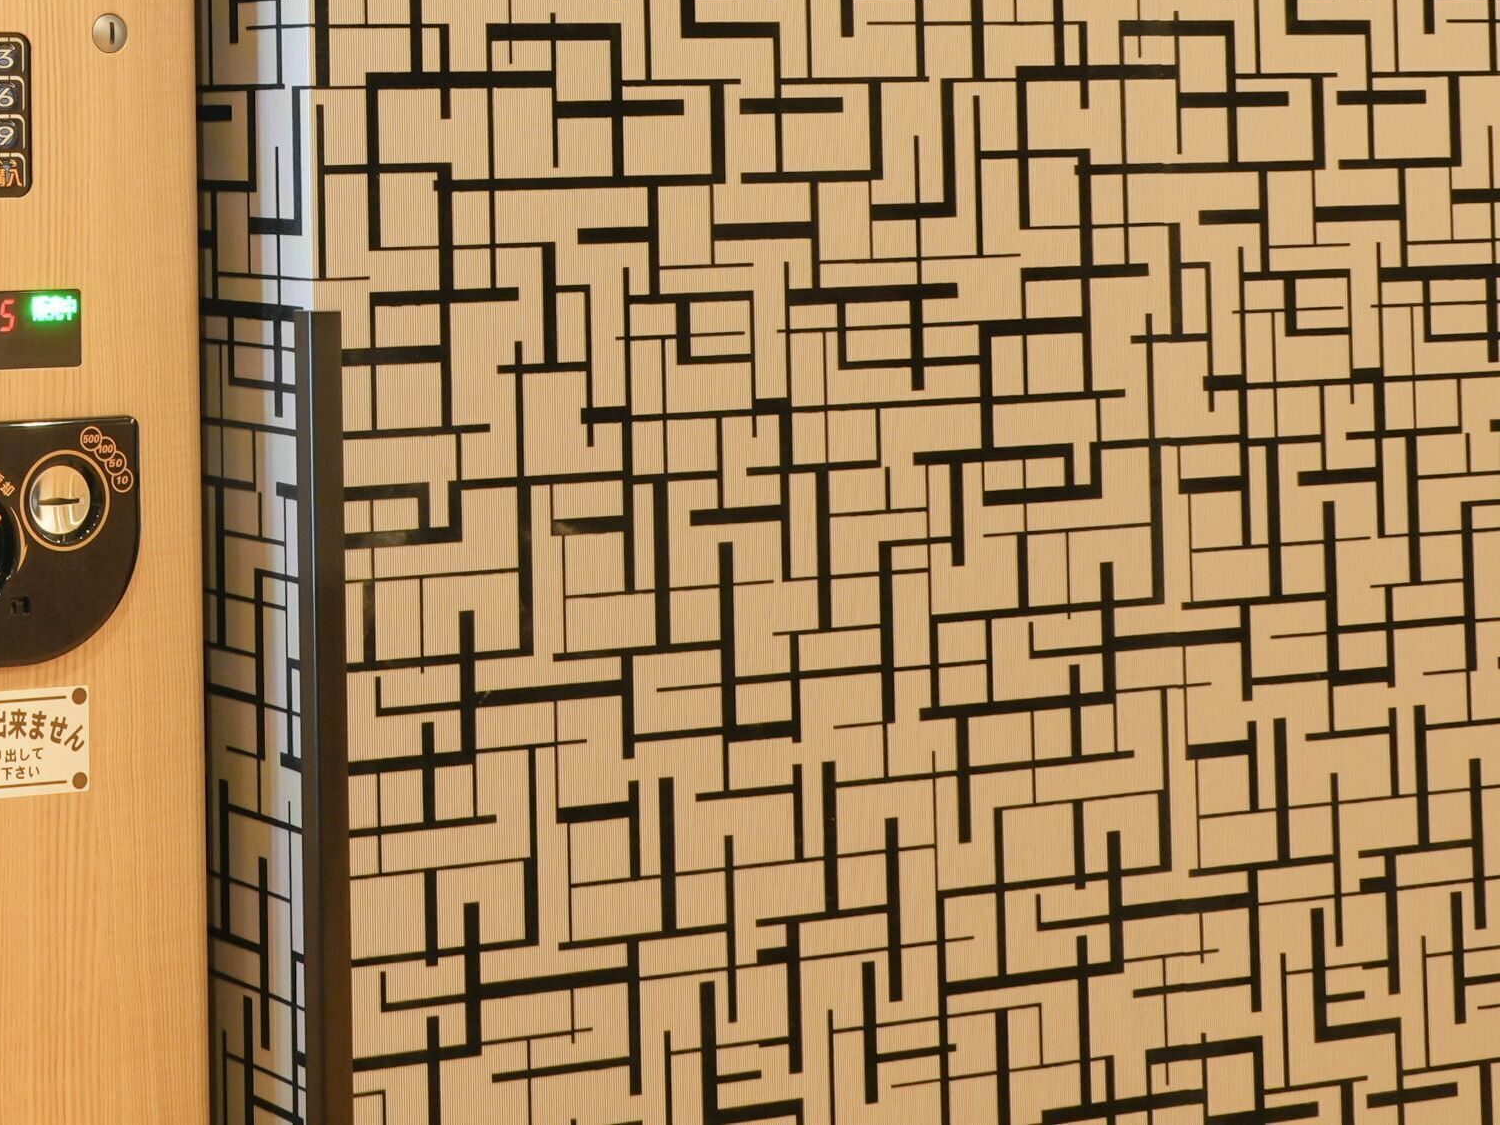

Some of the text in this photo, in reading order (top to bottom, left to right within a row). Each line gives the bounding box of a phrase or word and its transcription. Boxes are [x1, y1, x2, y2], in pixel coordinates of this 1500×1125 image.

[0, 298, 16, 333] 5
[82, 434, 100, 444] 500
[109, 459, 123, 468] 50
[115, 475, 128, 485] 10
